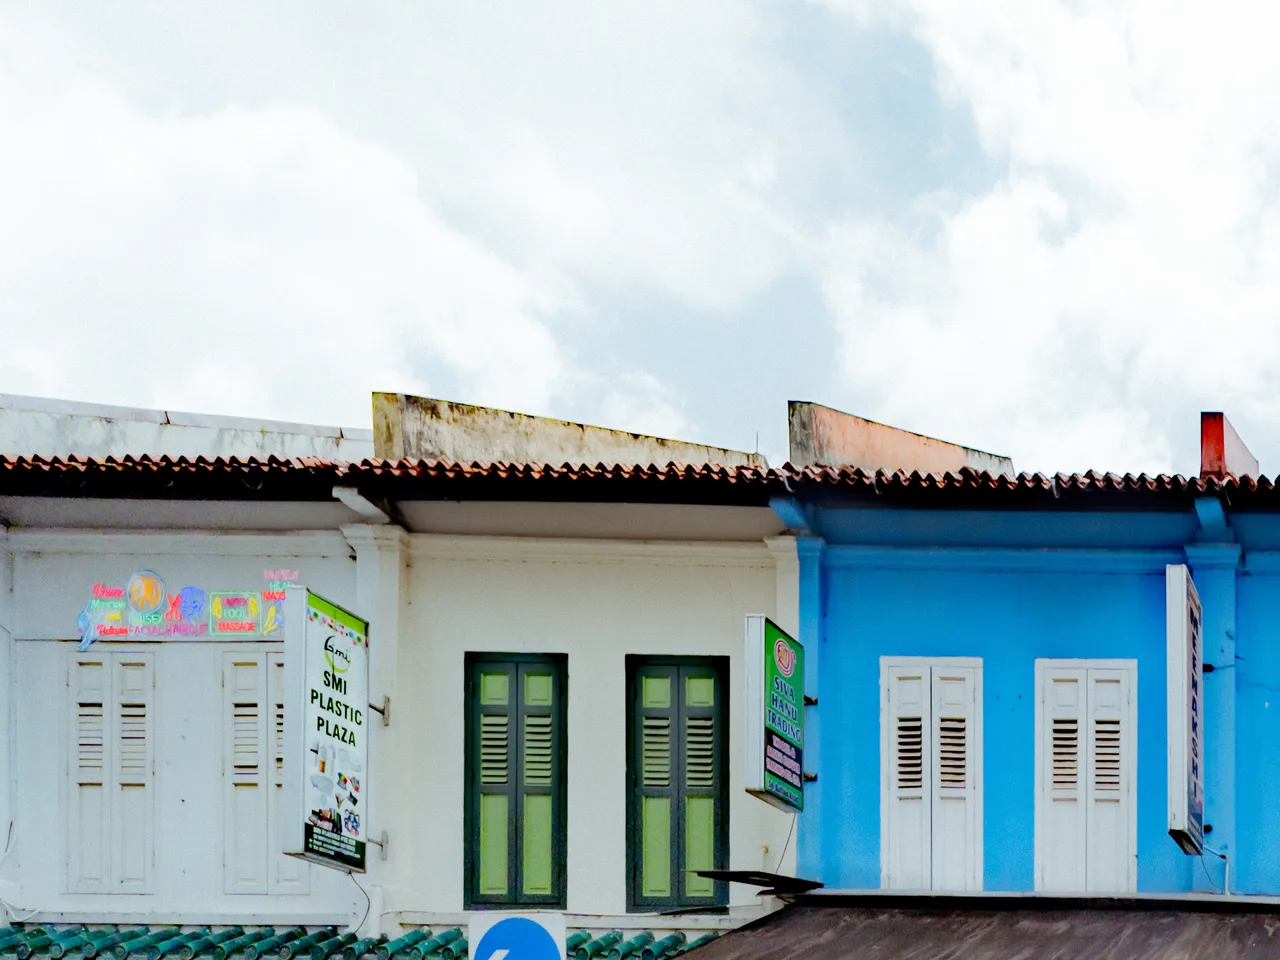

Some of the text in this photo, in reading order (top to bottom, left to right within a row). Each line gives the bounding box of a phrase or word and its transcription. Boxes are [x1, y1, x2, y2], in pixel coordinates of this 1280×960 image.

[129, 625, 164, 637] FACIAL
[164, 622, 208, 636] HAIRCUT
[217, 621, 256, 632] MASSAGE
[323, 669, 347, 695] SMI
[774, 675, 796, 702] SIVA
[310, 688, 363, 726] PLASTIC
[771, 692, 798, 722] HANU
[316, 715, 357, 748] PLAZA
[767, 707, 802, 742] TRADING
